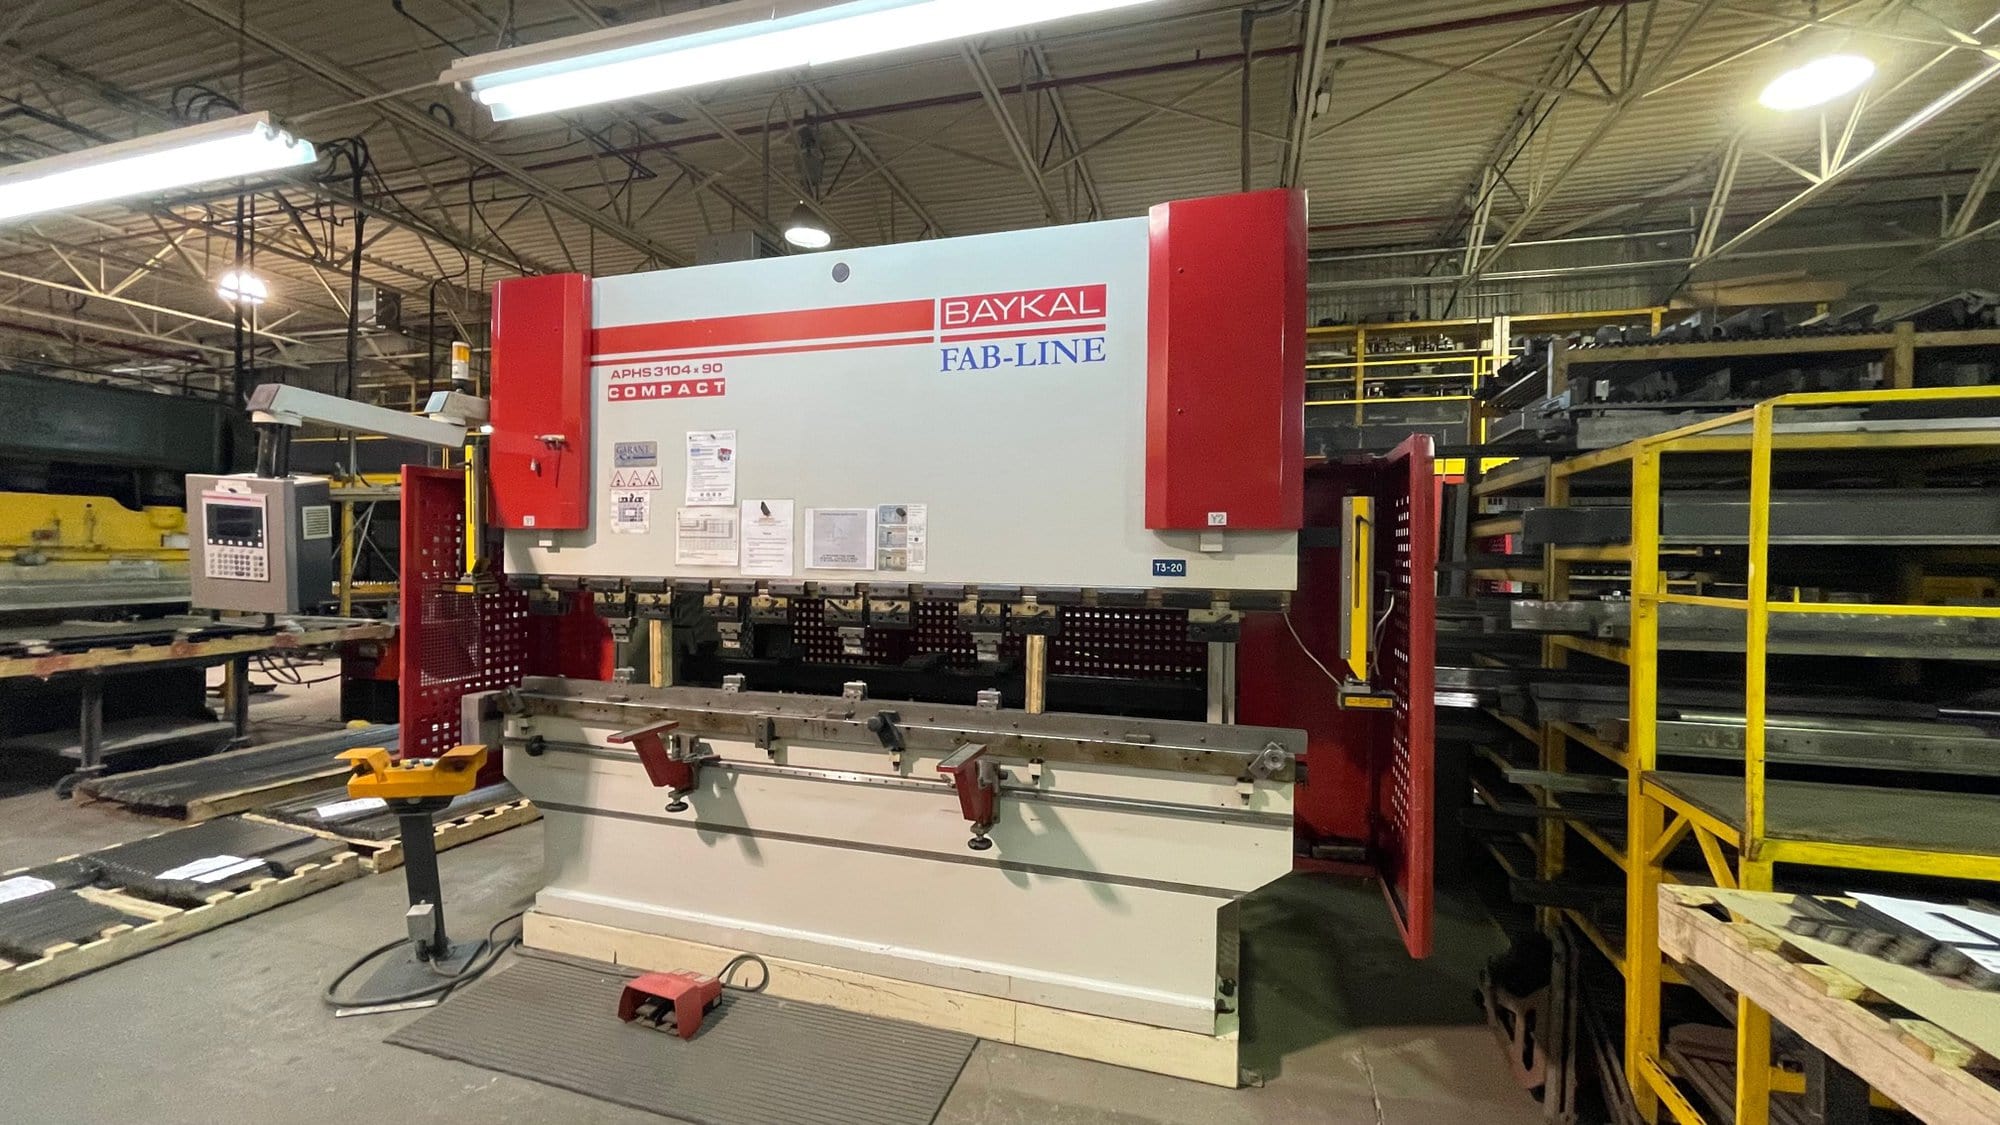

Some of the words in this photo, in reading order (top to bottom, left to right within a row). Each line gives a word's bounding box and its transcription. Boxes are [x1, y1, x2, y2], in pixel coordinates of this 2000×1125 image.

[945, 290, 1101, 325] BAYKAL
[940, 337, 1107, 372] FAB-LINE
[702, 363, 723, 374] 90
[608, 381, 725, 399] COMPACT
[1210, 513, 1225, 524] Y2
[1154, 562, 1183, 573] T3-20
